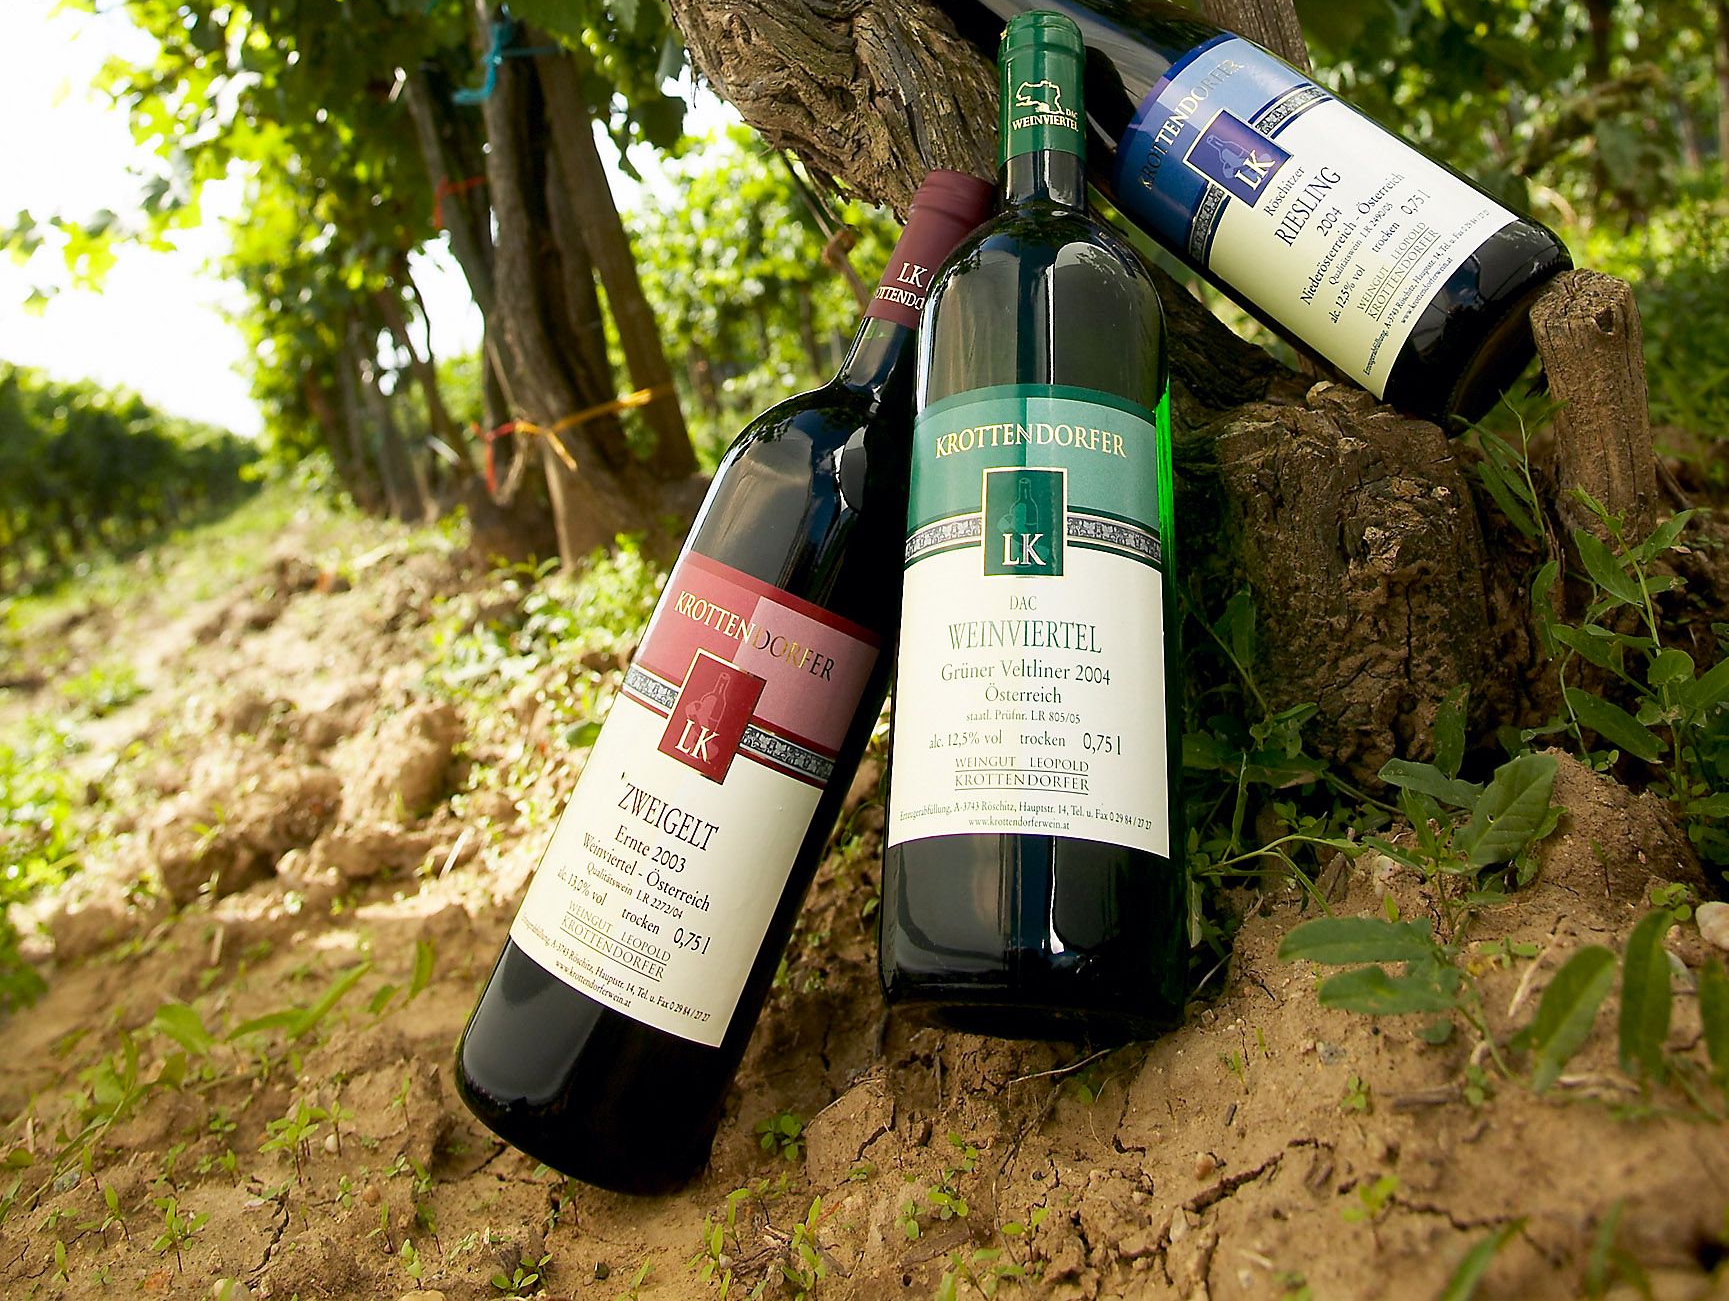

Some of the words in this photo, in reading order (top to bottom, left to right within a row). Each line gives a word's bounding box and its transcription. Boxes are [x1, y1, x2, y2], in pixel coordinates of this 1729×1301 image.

[1234, 150, 1276, 191] LK
[1263, 166, 1305, 217] Röschitzer
[1274, 166, 1341, 247] RIESLING
[1300, 222, 1357, 306] Niederösterreich
[1356, 172, 1405, 215] Österreich
[1317, 206, 1343, 238] 2004
[1352, 264, 1366, 282] vol
[1372, 222, 1400, 253] trocken
[1357, 265, 1389, 311] WEINGUT
[1391, 222, 1426, 260] LEOPOLD
[896, 262, 928, 288] LK
[1368, 229, 1439, 319] KROTTENDORFER
[935, 423, 1127, 459] KROTTENDORFER
[1002, 533, 1047, 566] LK
[1009, 595, 1037, 611] DAC
[674, 590, 835, 682] KROTTENDORFER
[948, 619, 1103, 653] WEINVIERTEL
[941, 661, 995, 681] Grüner
[1001, 659, 1071, 680] Veltliner
[1075, 665, 1111, 685] 2004
[985, 682, 1062, 704] Österreich
[1031, 710, 1045, 721] LR
[675, 719, 720, 765] LK
[948, 731, 980, 748] 12,5%
[985, 729, 1002, 744] vol
[1020, 730, 1066, 747] trocken
[955, 756, 1016, 767] WEINGUT
[1030, 757, 1089, 772] LEOPOLD
[955, 773, 1090, 791] KROTTENDORFER
[1095, 808, 1108, 820] Fax
[614, 824, 650, 857] Ernte
[651, 846, 686, 873] 2003
[583, 832, 638, 876] Weinviertel
[646, 868, 710, 912] Österreich
[592, 891, 608, 906] vol
[622, 907, 660, 935] trocken
[636, 889, 649, 904] LR
[561, 915, 665, 979] KROTTENDORFER
[568, 900, 613, 934] WEINGUT
[621, 932, 671, 962] LEOPOLD
